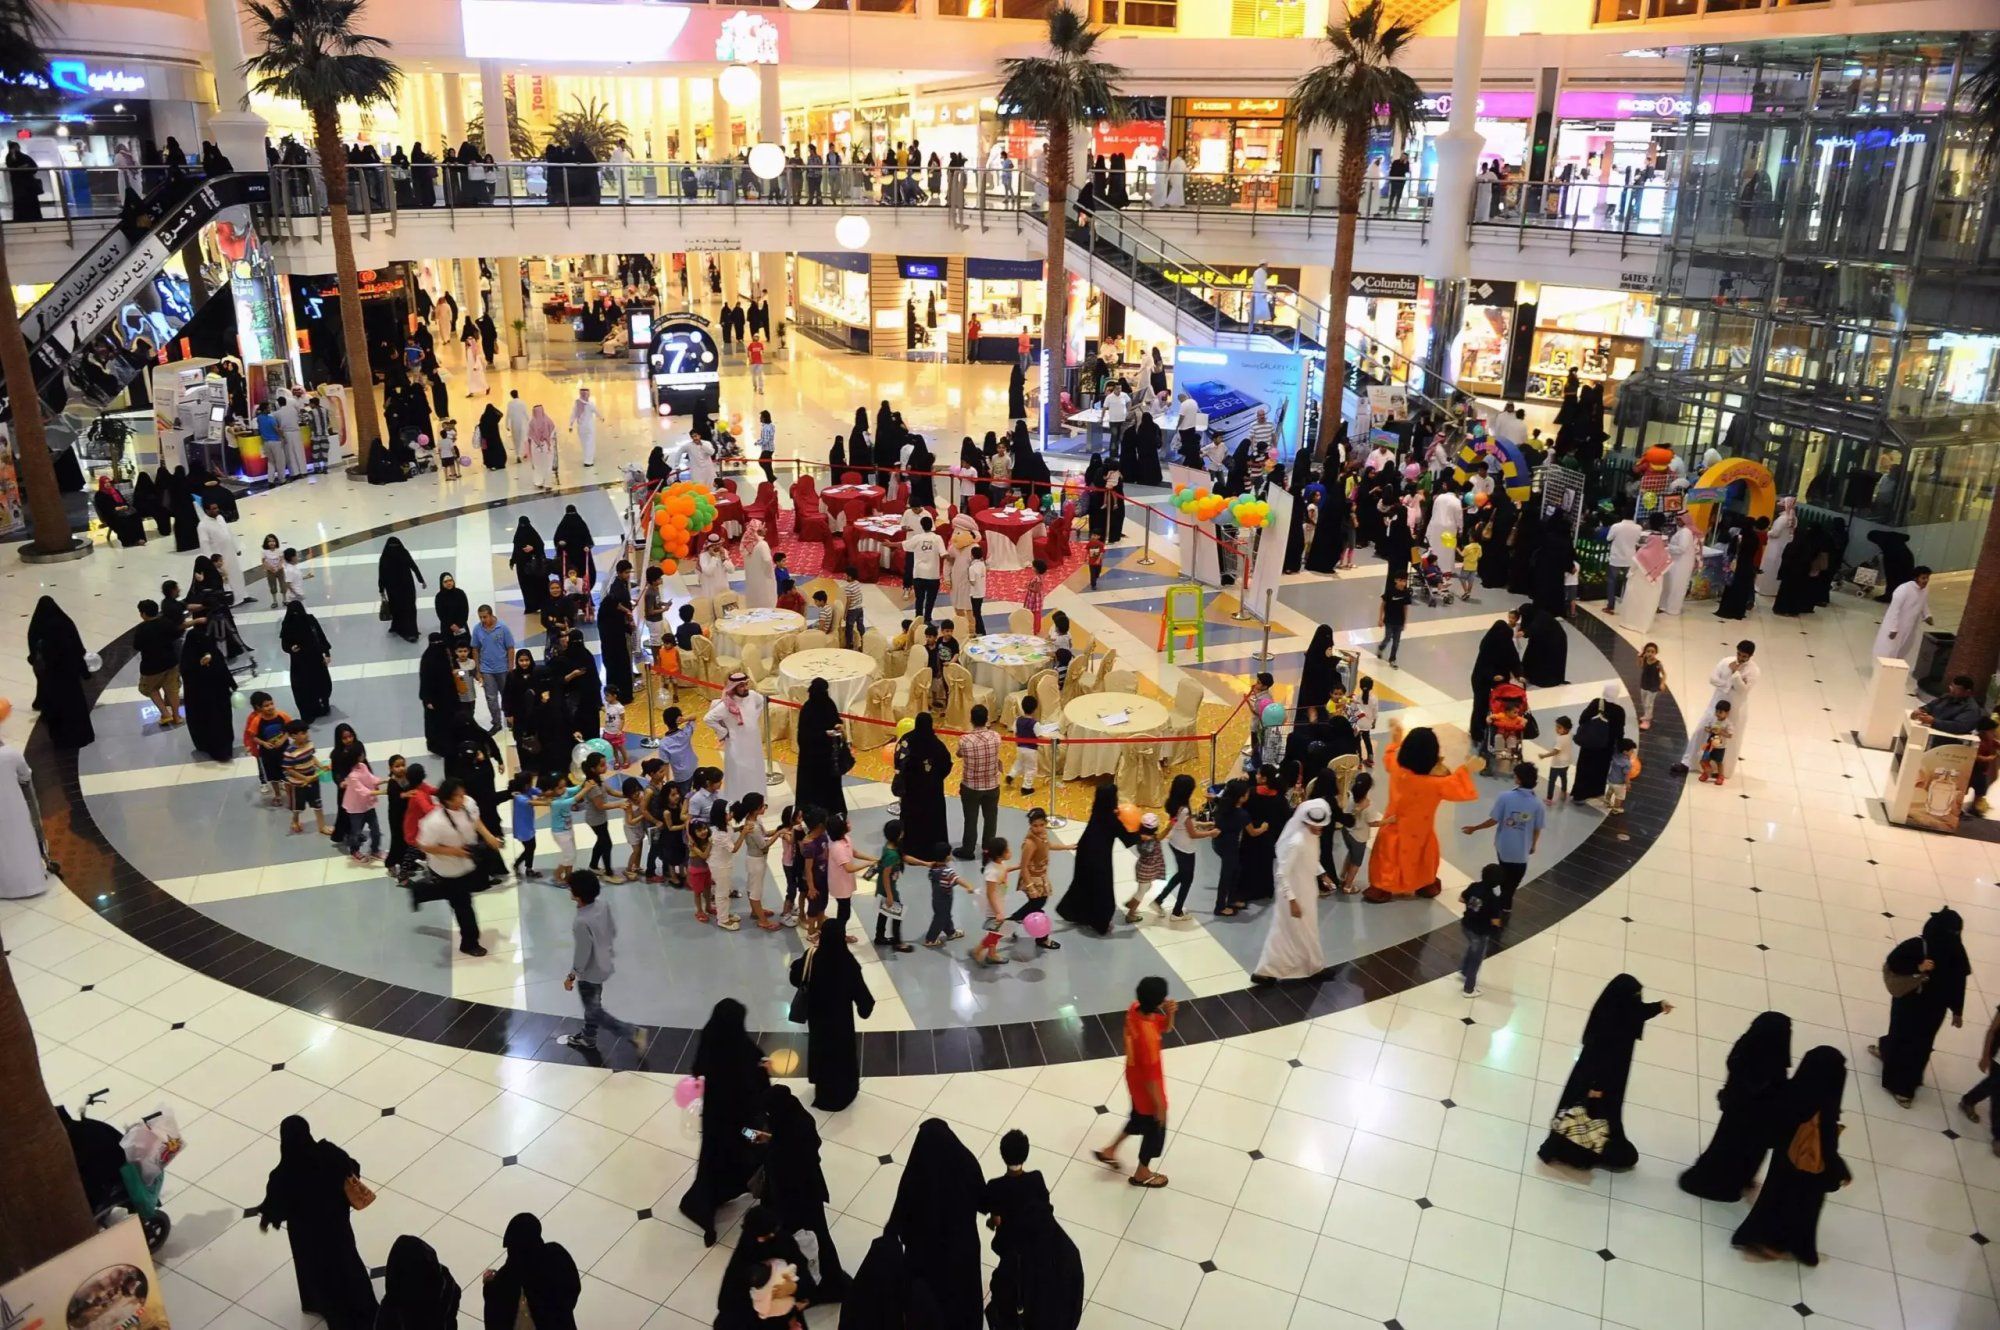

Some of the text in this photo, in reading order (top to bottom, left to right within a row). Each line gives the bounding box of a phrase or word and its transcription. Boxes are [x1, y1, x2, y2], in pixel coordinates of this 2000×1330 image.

[109, 244, 121, 255] لا
[143, 248, 154, 260] لا
[107, 271, 132, 302] لمزيل
[1365, 276, 1416, 290] Columbia
[1621, 273, 1648, 284] GATES
[48, 290, 74, 319] العرق
[82, 296, 108, 325] العرق
[664, 341, 689, 374] 7
